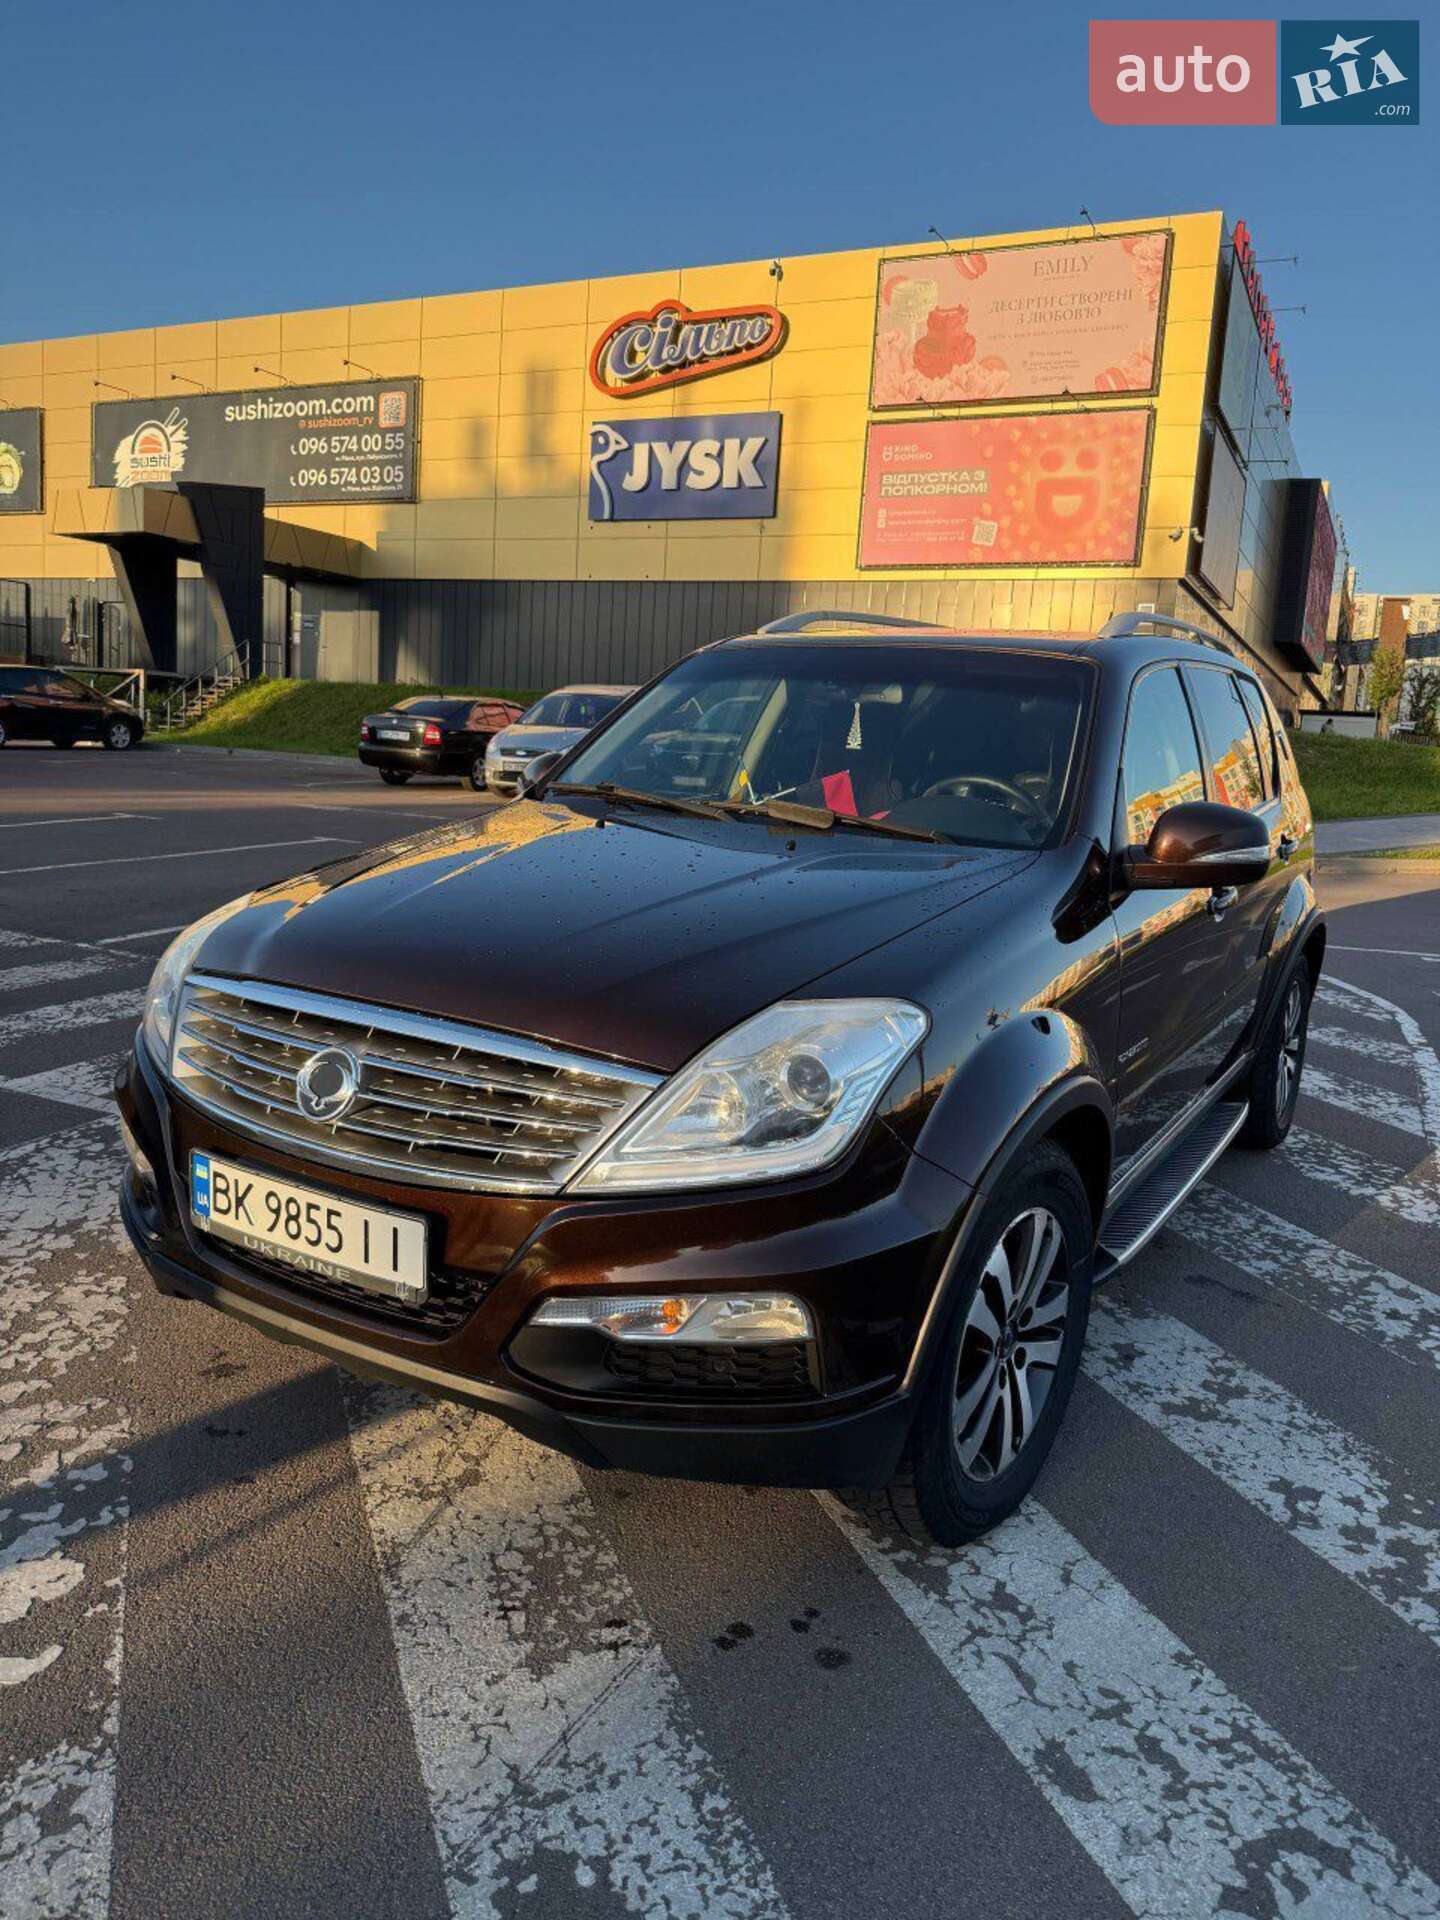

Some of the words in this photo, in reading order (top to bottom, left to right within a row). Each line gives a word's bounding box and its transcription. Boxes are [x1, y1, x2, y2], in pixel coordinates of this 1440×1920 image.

[1032, 255, 1094, 277] EMILY
[989, 295, 1056, 313] ДЕСЕРТИ
[1058, 289, 1133, 307] СТВОРЕНІ
[608, 313, 772, 379] Сільпо
[225, 395, 375, 422] sushizoom.com
[298, 437, 328, 456] 096
[331, 434, 358, 454] 574
[361, 433, 382, 452] 00
[384, 432, 405, 450] 55
[298, 468, 328, 487] 096
[330, 467, 357, 485] 574
[360, 466, 380, 484] 03
[383, 465, 404, 483] 05
[622, 437, 768, 492] JYSK
[881, 482, 988, 497] ПОПКОРНОМ!
[882, 472, 970, 485] ВІДПУСТКА
[197, 1191, 209, 1207] UA
[212, 1171, 254, 1226] BK
[264, 1190, 343, 1254] 9855
[243, 1235, 350, 1280] UKRAINE
